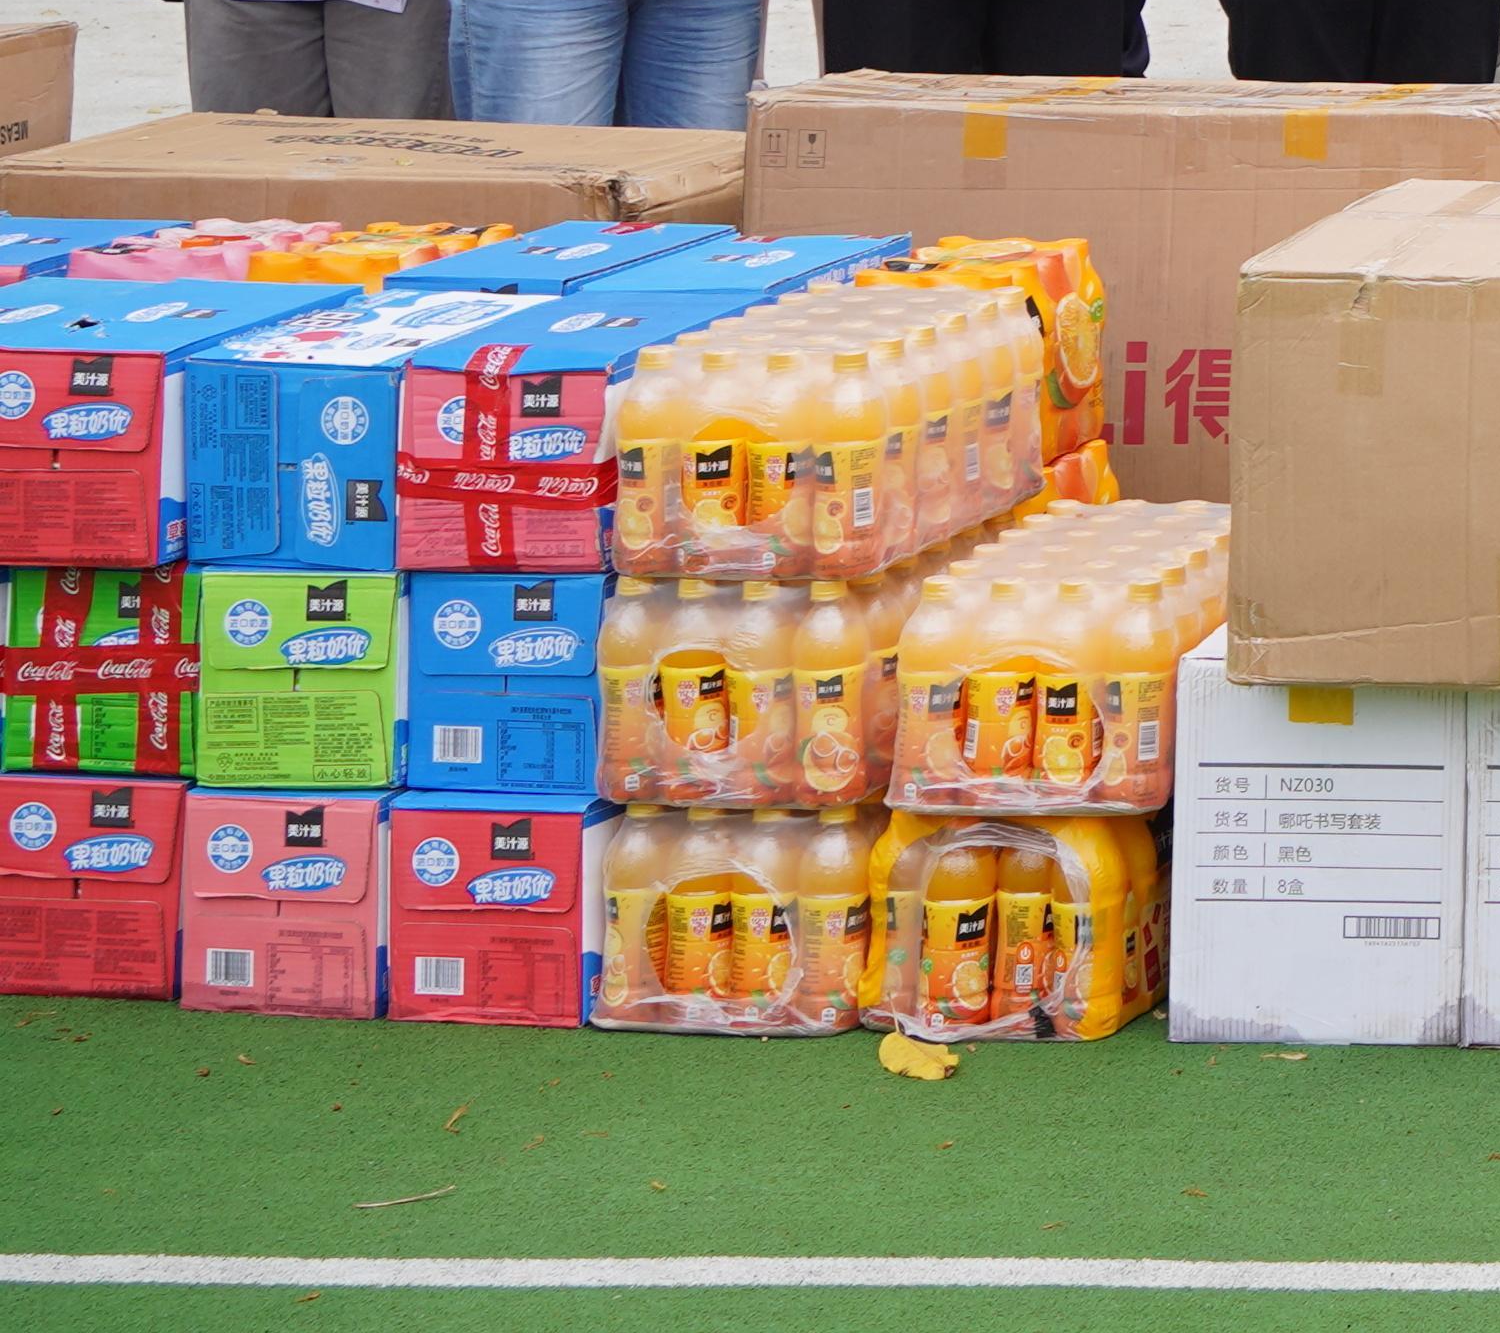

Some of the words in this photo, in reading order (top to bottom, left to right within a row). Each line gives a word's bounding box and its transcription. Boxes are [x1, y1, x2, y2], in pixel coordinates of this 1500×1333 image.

[73, 372, 109, 388] 美汁源
[524, 393, 560, 409] 美汁源
[48, 408, 133, 440] 果粒奶优
[696, 458, 729, 474] 美汁源
[309, 597, 345, 614] 美汁源
[516, 598, 551, 612] 美汁源
[288, 634, 369, 665] 果粒奶优
[496, 635, 575, 667] 果粒奶优
[1048, 696, 1075, 710] 美汁源
[1216, 777, 1250, 793] 货号
[1281, 778, 1333, 792] NZ030
[94, 804, 129, 819] 美汁源
[1215, 811, 1248, 827] 货名
[1277, 813, 1381, 831] 哪吒书写套装
[287, 823, 322, 838] 美汁源
[494, 836, 529, 850] 美汁源
[69, 843, 151, 870] 果粒奶优
[1213, 845, 1248, 860] 颜色
[1278, 846, 1312, 862] 黑色
[268, 863, 346, 891] 果粒奶优
[474, 875, 553, 904] 果粒奶优
[1212, 879, 1247, 894] 数量
[1277, 879, 1304, 895] 8盒
[958, 917, 986, 934] 美汁源
